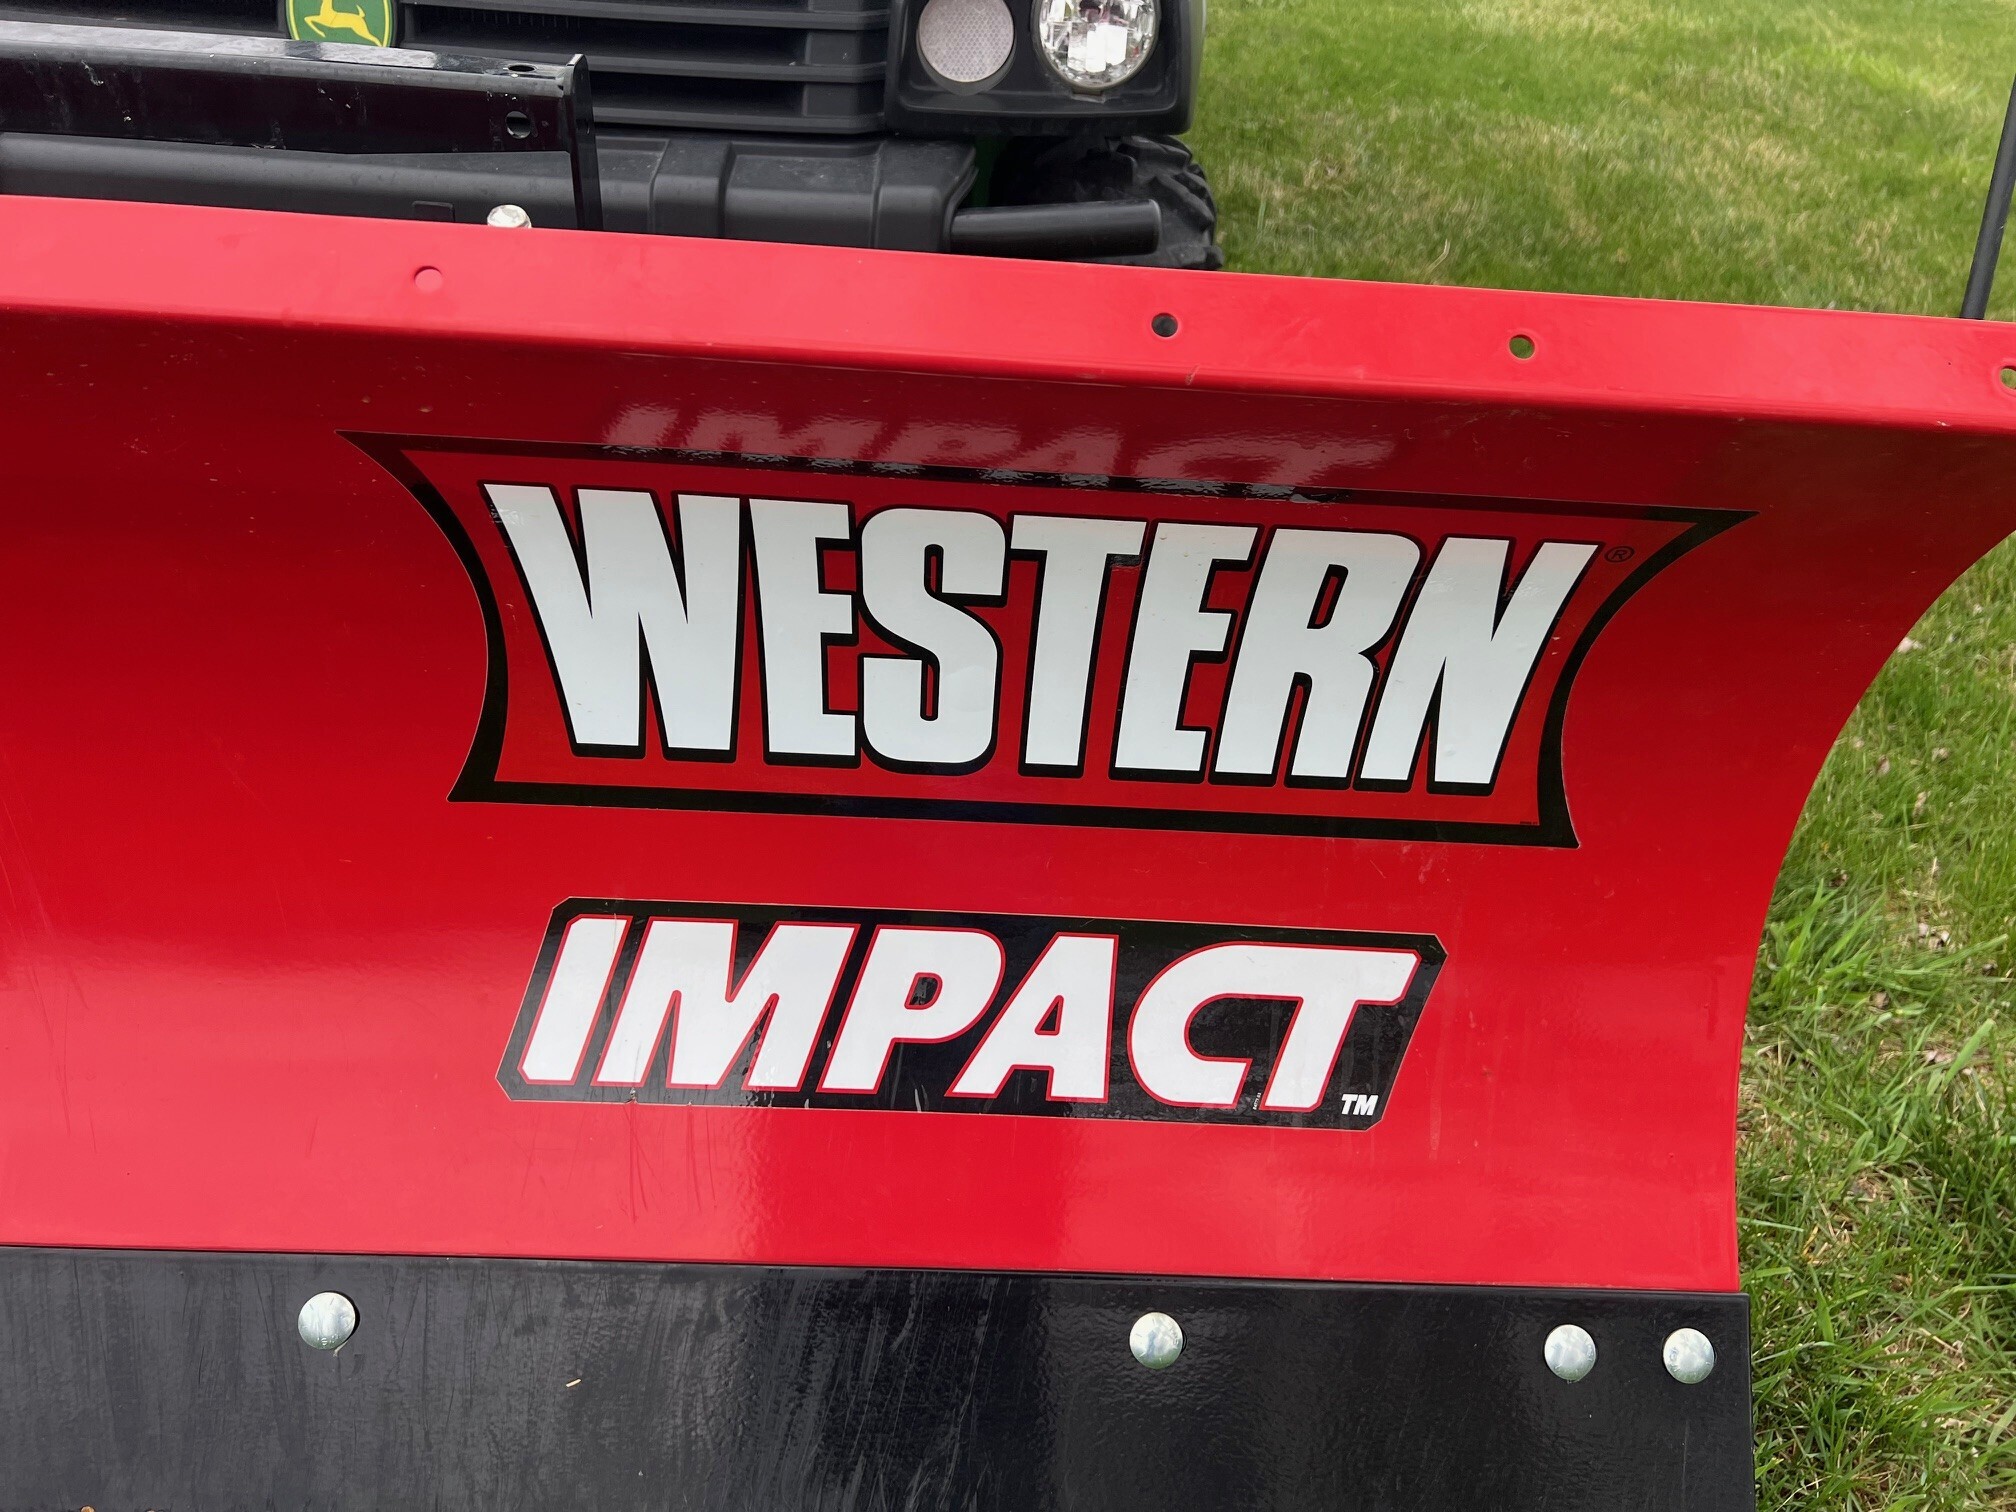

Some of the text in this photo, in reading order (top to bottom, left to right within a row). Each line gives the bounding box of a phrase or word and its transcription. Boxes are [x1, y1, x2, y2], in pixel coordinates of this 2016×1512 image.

[484, 482, 1599, 785] WESTERN
[518, 916, 1420, 1116] IMPACT TM
